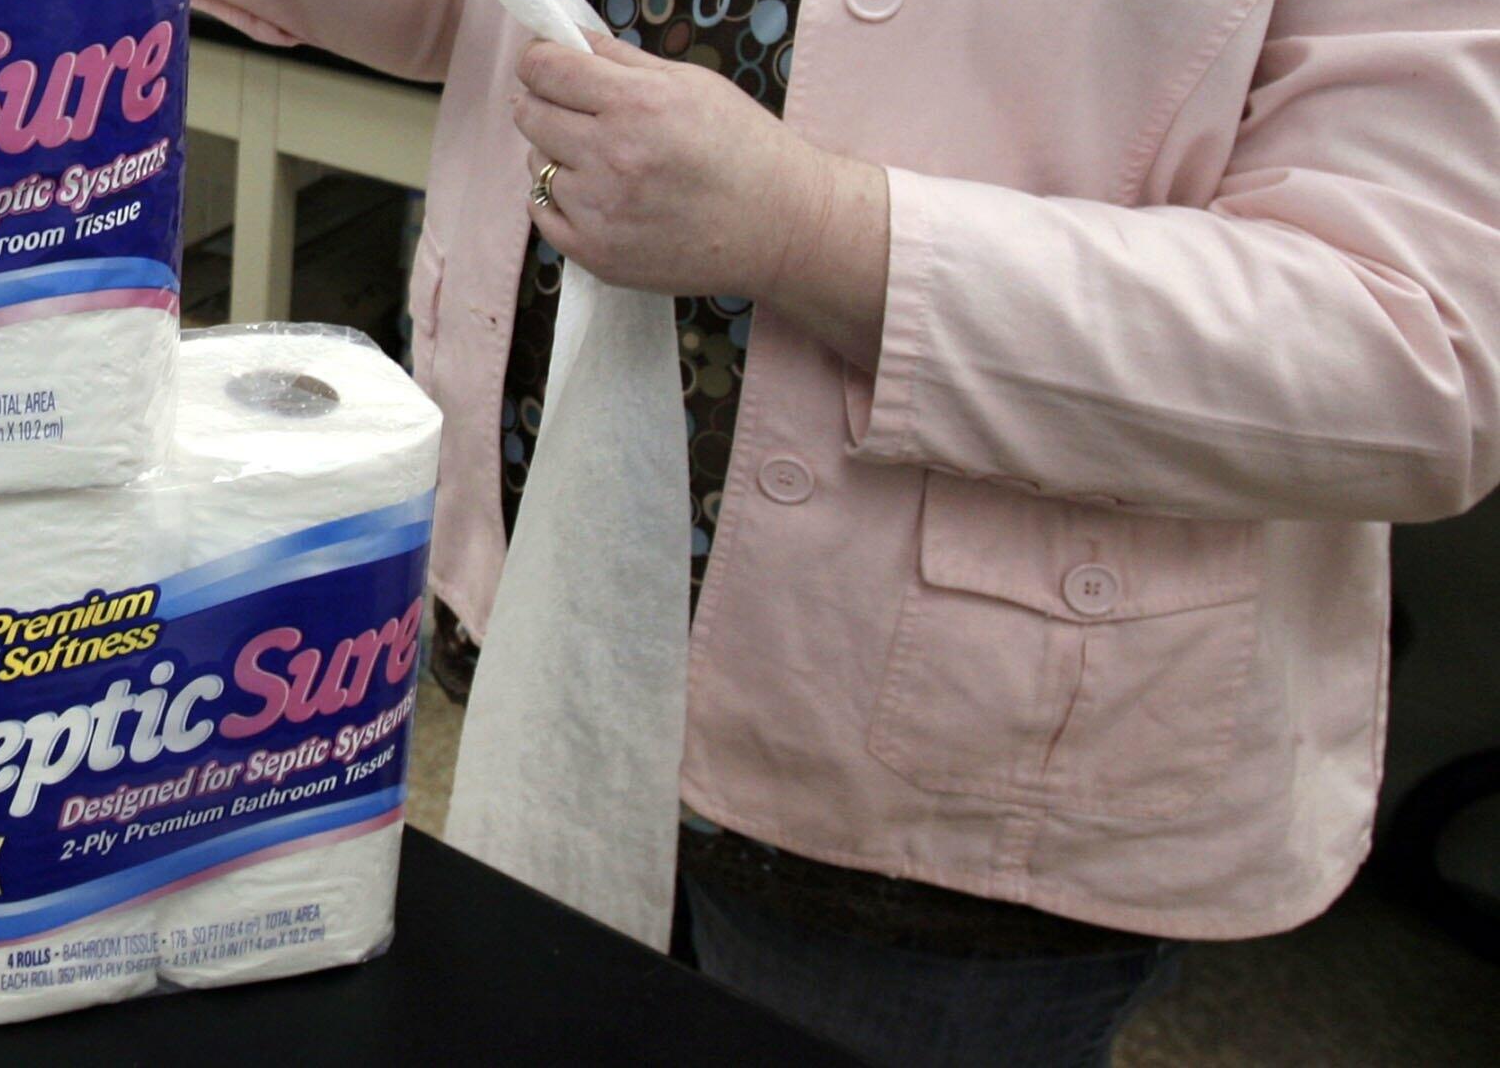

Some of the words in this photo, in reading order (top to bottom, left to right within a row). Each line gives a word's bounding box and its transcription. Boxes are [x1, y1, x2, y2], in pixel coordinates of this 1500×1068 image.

[59, 139, 169, 210] Systems
[75, 201, 141, 240] Tissue
[7, 421, 15, 442] X
[19, 419, 41, 440] 10.2
[44, 417, 63, 440] cm)
[25, 391, 55, 413] AREA
[61, 769, 196, 828] Designed
[199, 761, 242, 794] for
[247, 737, 331, 781] Septic
[60, 831, 118, 861] 2-Ply
[123, 804, 224, 844] Premium
[230, 774, 337, 816] Bathroom
